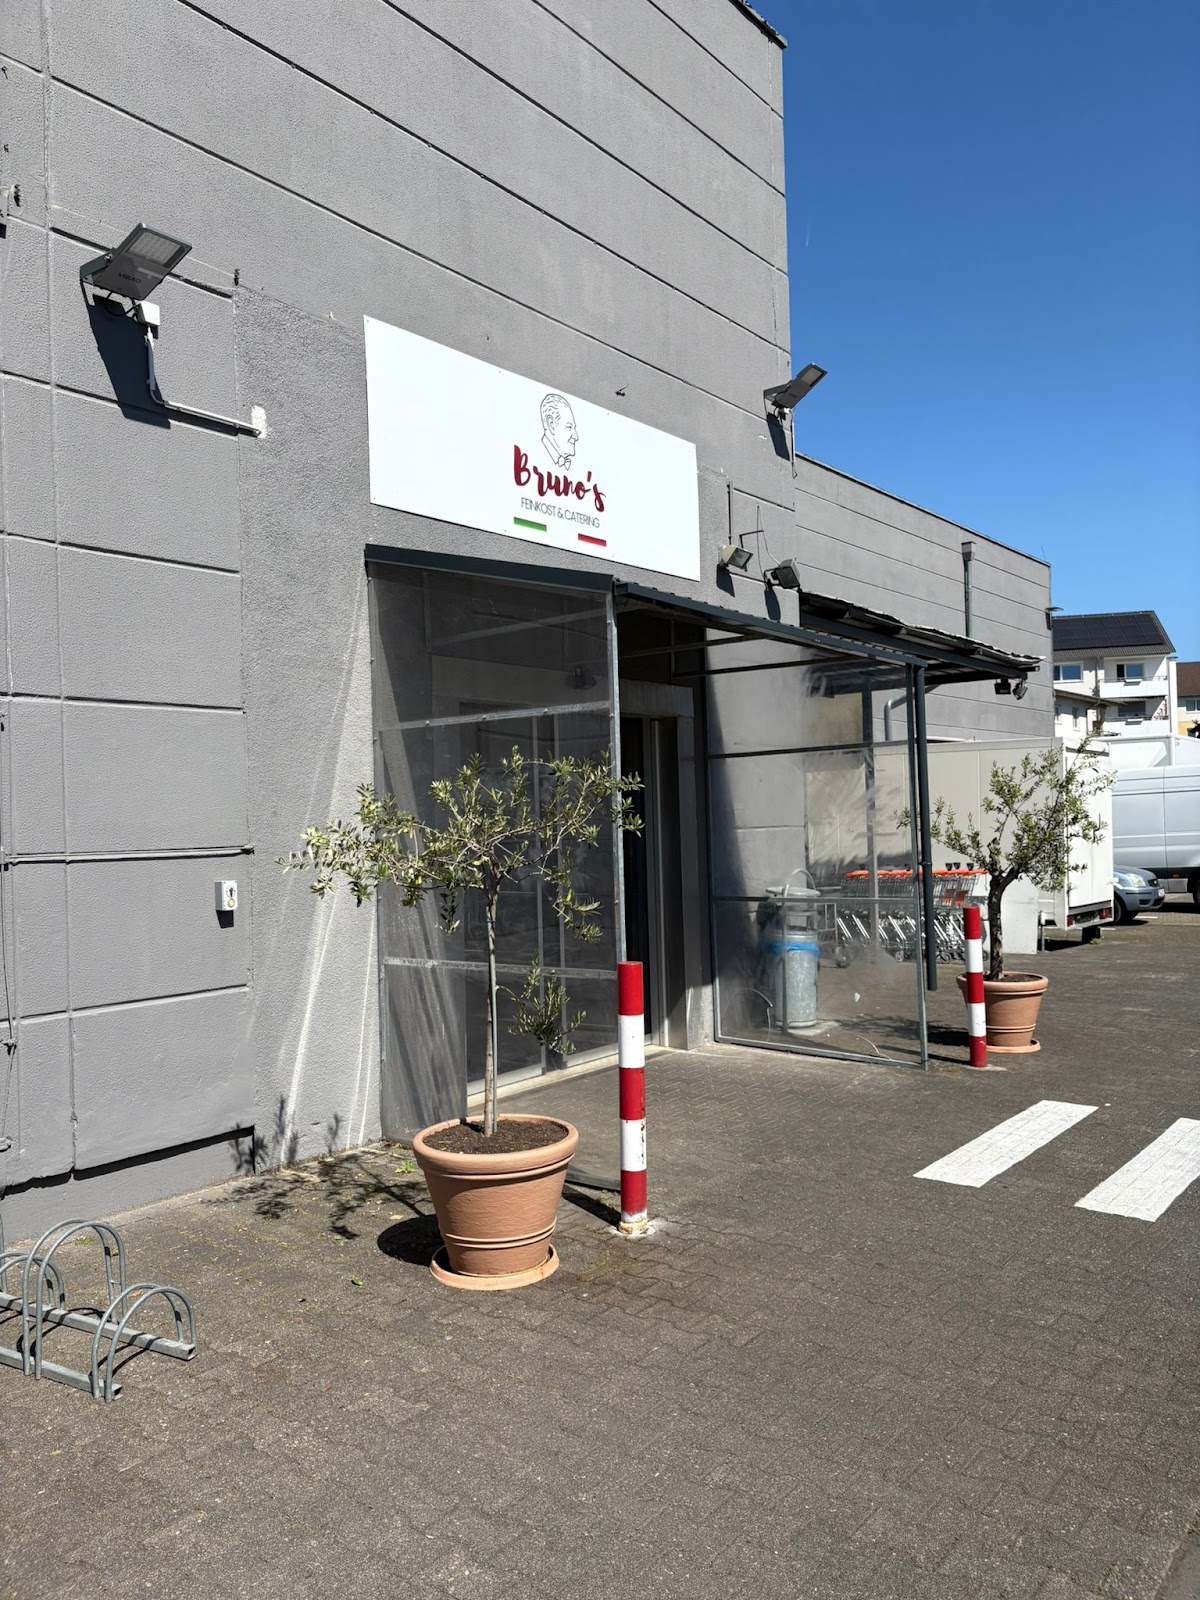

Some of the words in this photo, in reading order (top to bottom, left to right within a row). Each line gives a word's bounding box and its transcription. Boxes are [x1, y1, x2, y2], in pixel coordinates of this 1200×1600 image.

[513, 444, 607, 512] Bruno's
[521, 497, 556, 516] FEINKOST
[557, 507, 565, 519] &
[564, 509, 601, 528] CATERING
